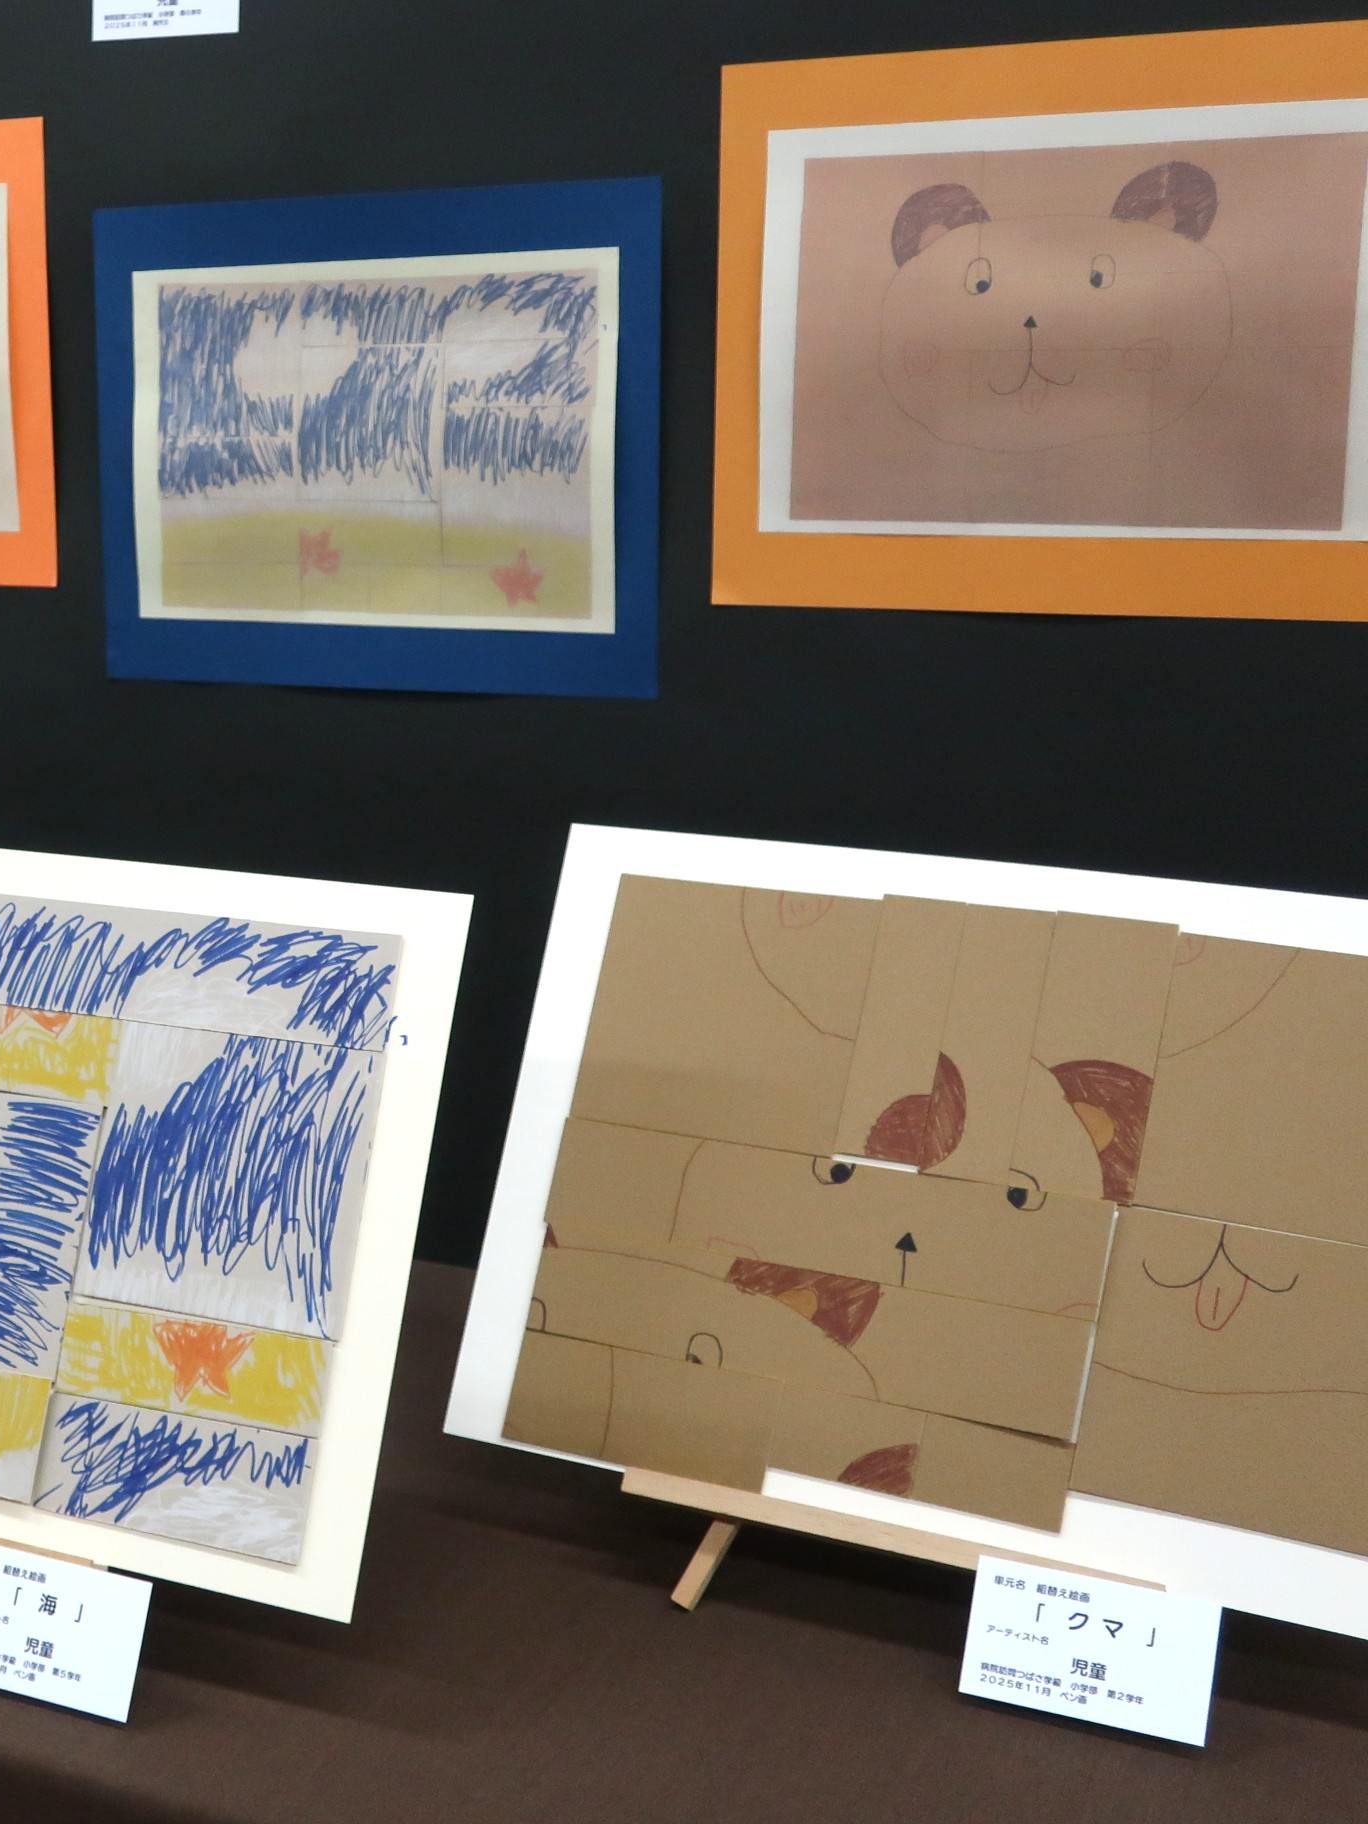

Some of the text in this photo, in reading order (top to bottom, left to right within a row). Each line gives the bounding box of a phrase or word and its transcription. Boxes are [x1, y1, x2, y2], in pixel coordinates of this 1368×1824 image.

[994, 1575, 1091, 1603] 単元名 組替え絵画
[986, 1624, 1049, 1646] アーティスト名
[24, 1636, 55, 1659] 児童
[1070, 1657, 1107, 1681] 児童
[979, 1673, 1051, 1697] 2025年11月
